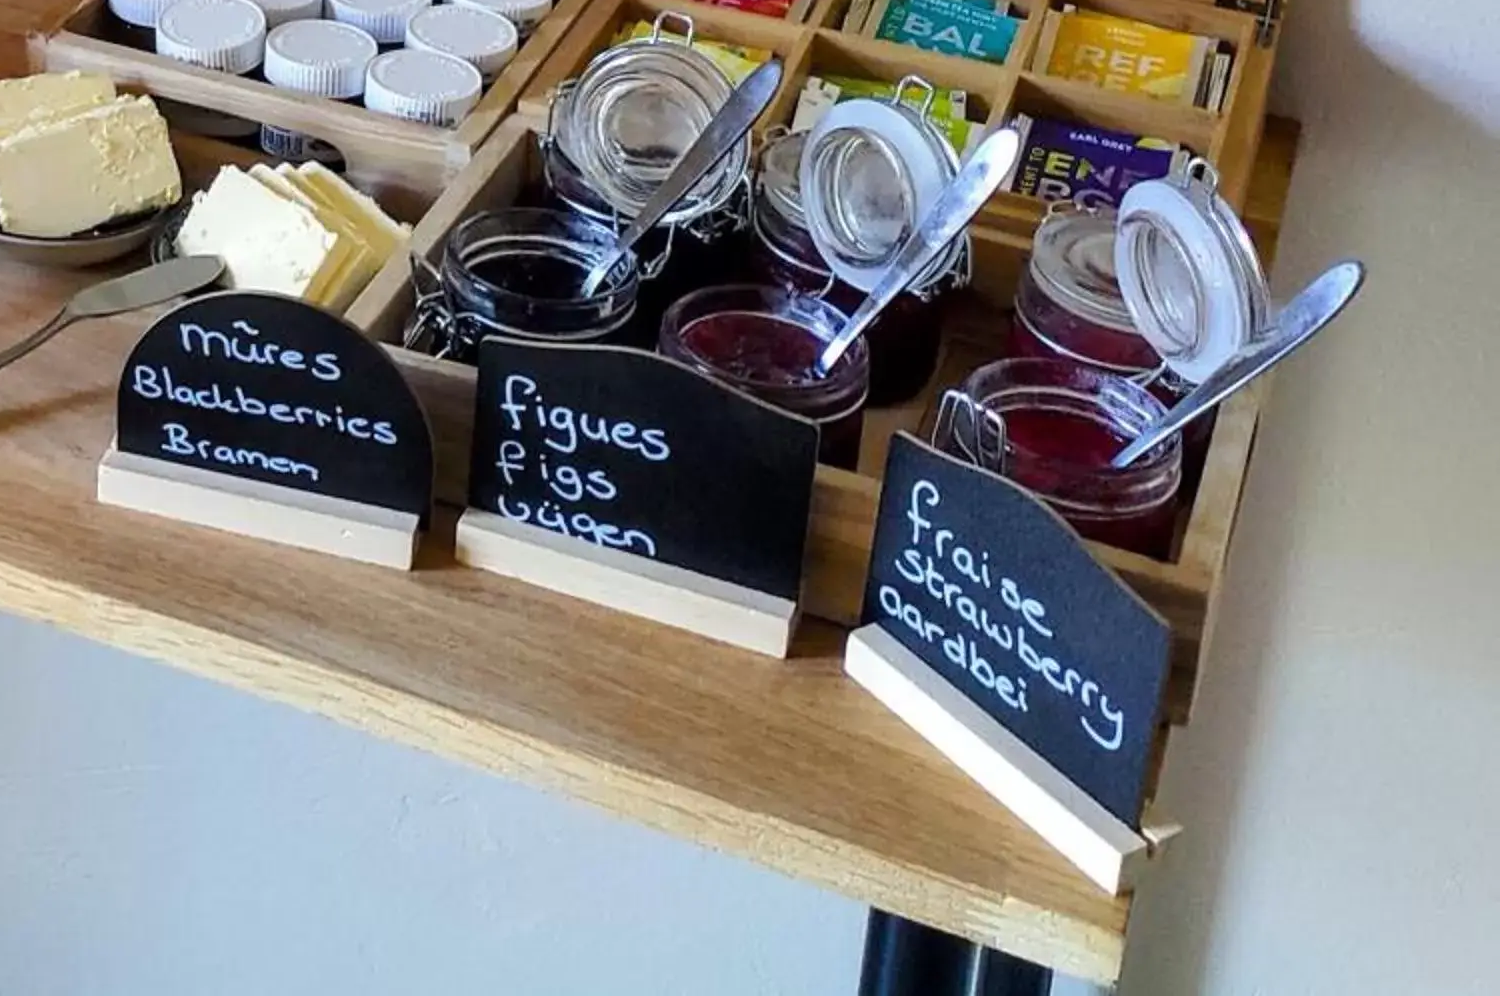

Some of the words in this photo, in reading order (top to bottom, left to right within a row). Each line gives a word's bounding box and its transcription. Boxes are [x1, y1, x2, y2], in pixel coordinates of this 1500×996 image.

[902, 11, 988, 57] BAL
[1073, 44, 1166, 77] REF
[1069, 132, 1099, 146] EARL
[1101, 139, 1133, 153] GREY
[132, 364, 399, 446] Blackberries
[161, 422, 320, 483] Bramen
